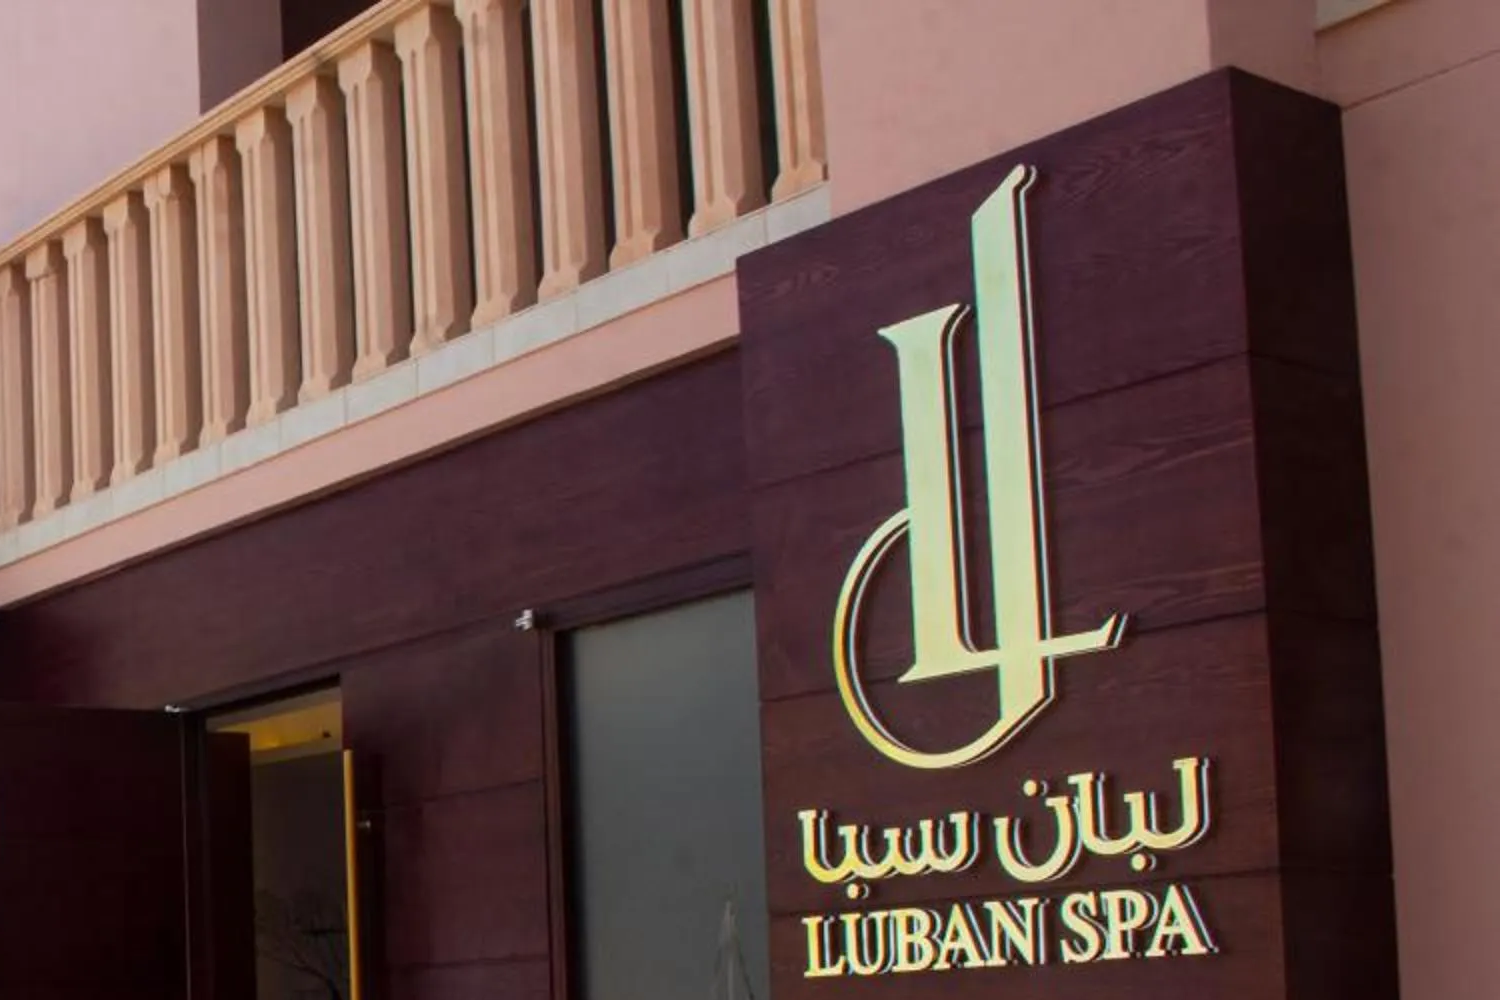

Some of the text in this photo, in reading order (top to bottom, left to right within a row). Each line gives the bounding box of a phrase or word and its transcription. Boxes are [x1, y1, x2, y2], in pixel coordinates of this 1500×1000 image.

[994, 757, 1202, 882] لبان
[802, 884, 1210, 978] LUBAN SPA
